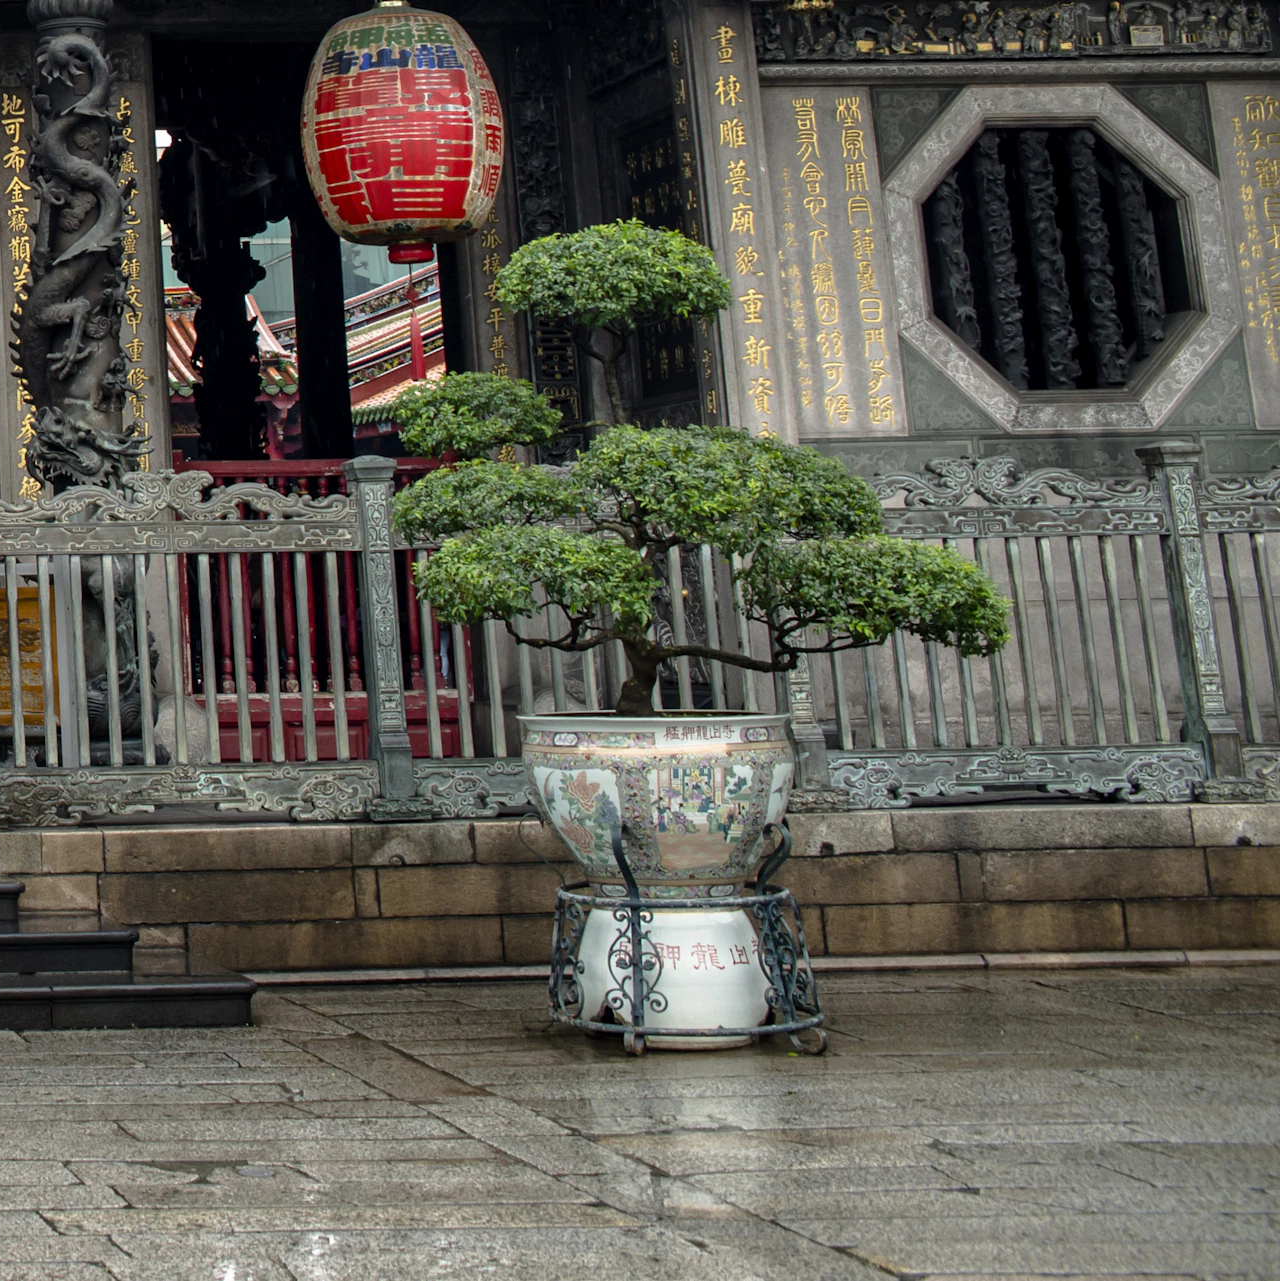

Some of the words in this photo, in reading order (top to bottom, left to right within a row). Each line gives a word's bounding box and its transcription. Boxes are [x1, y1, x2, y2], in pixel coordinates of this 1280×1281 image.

[322, 45, 464, 75] 龍山寺
[663, 725, 735, 742] 艋舺龍山寺
